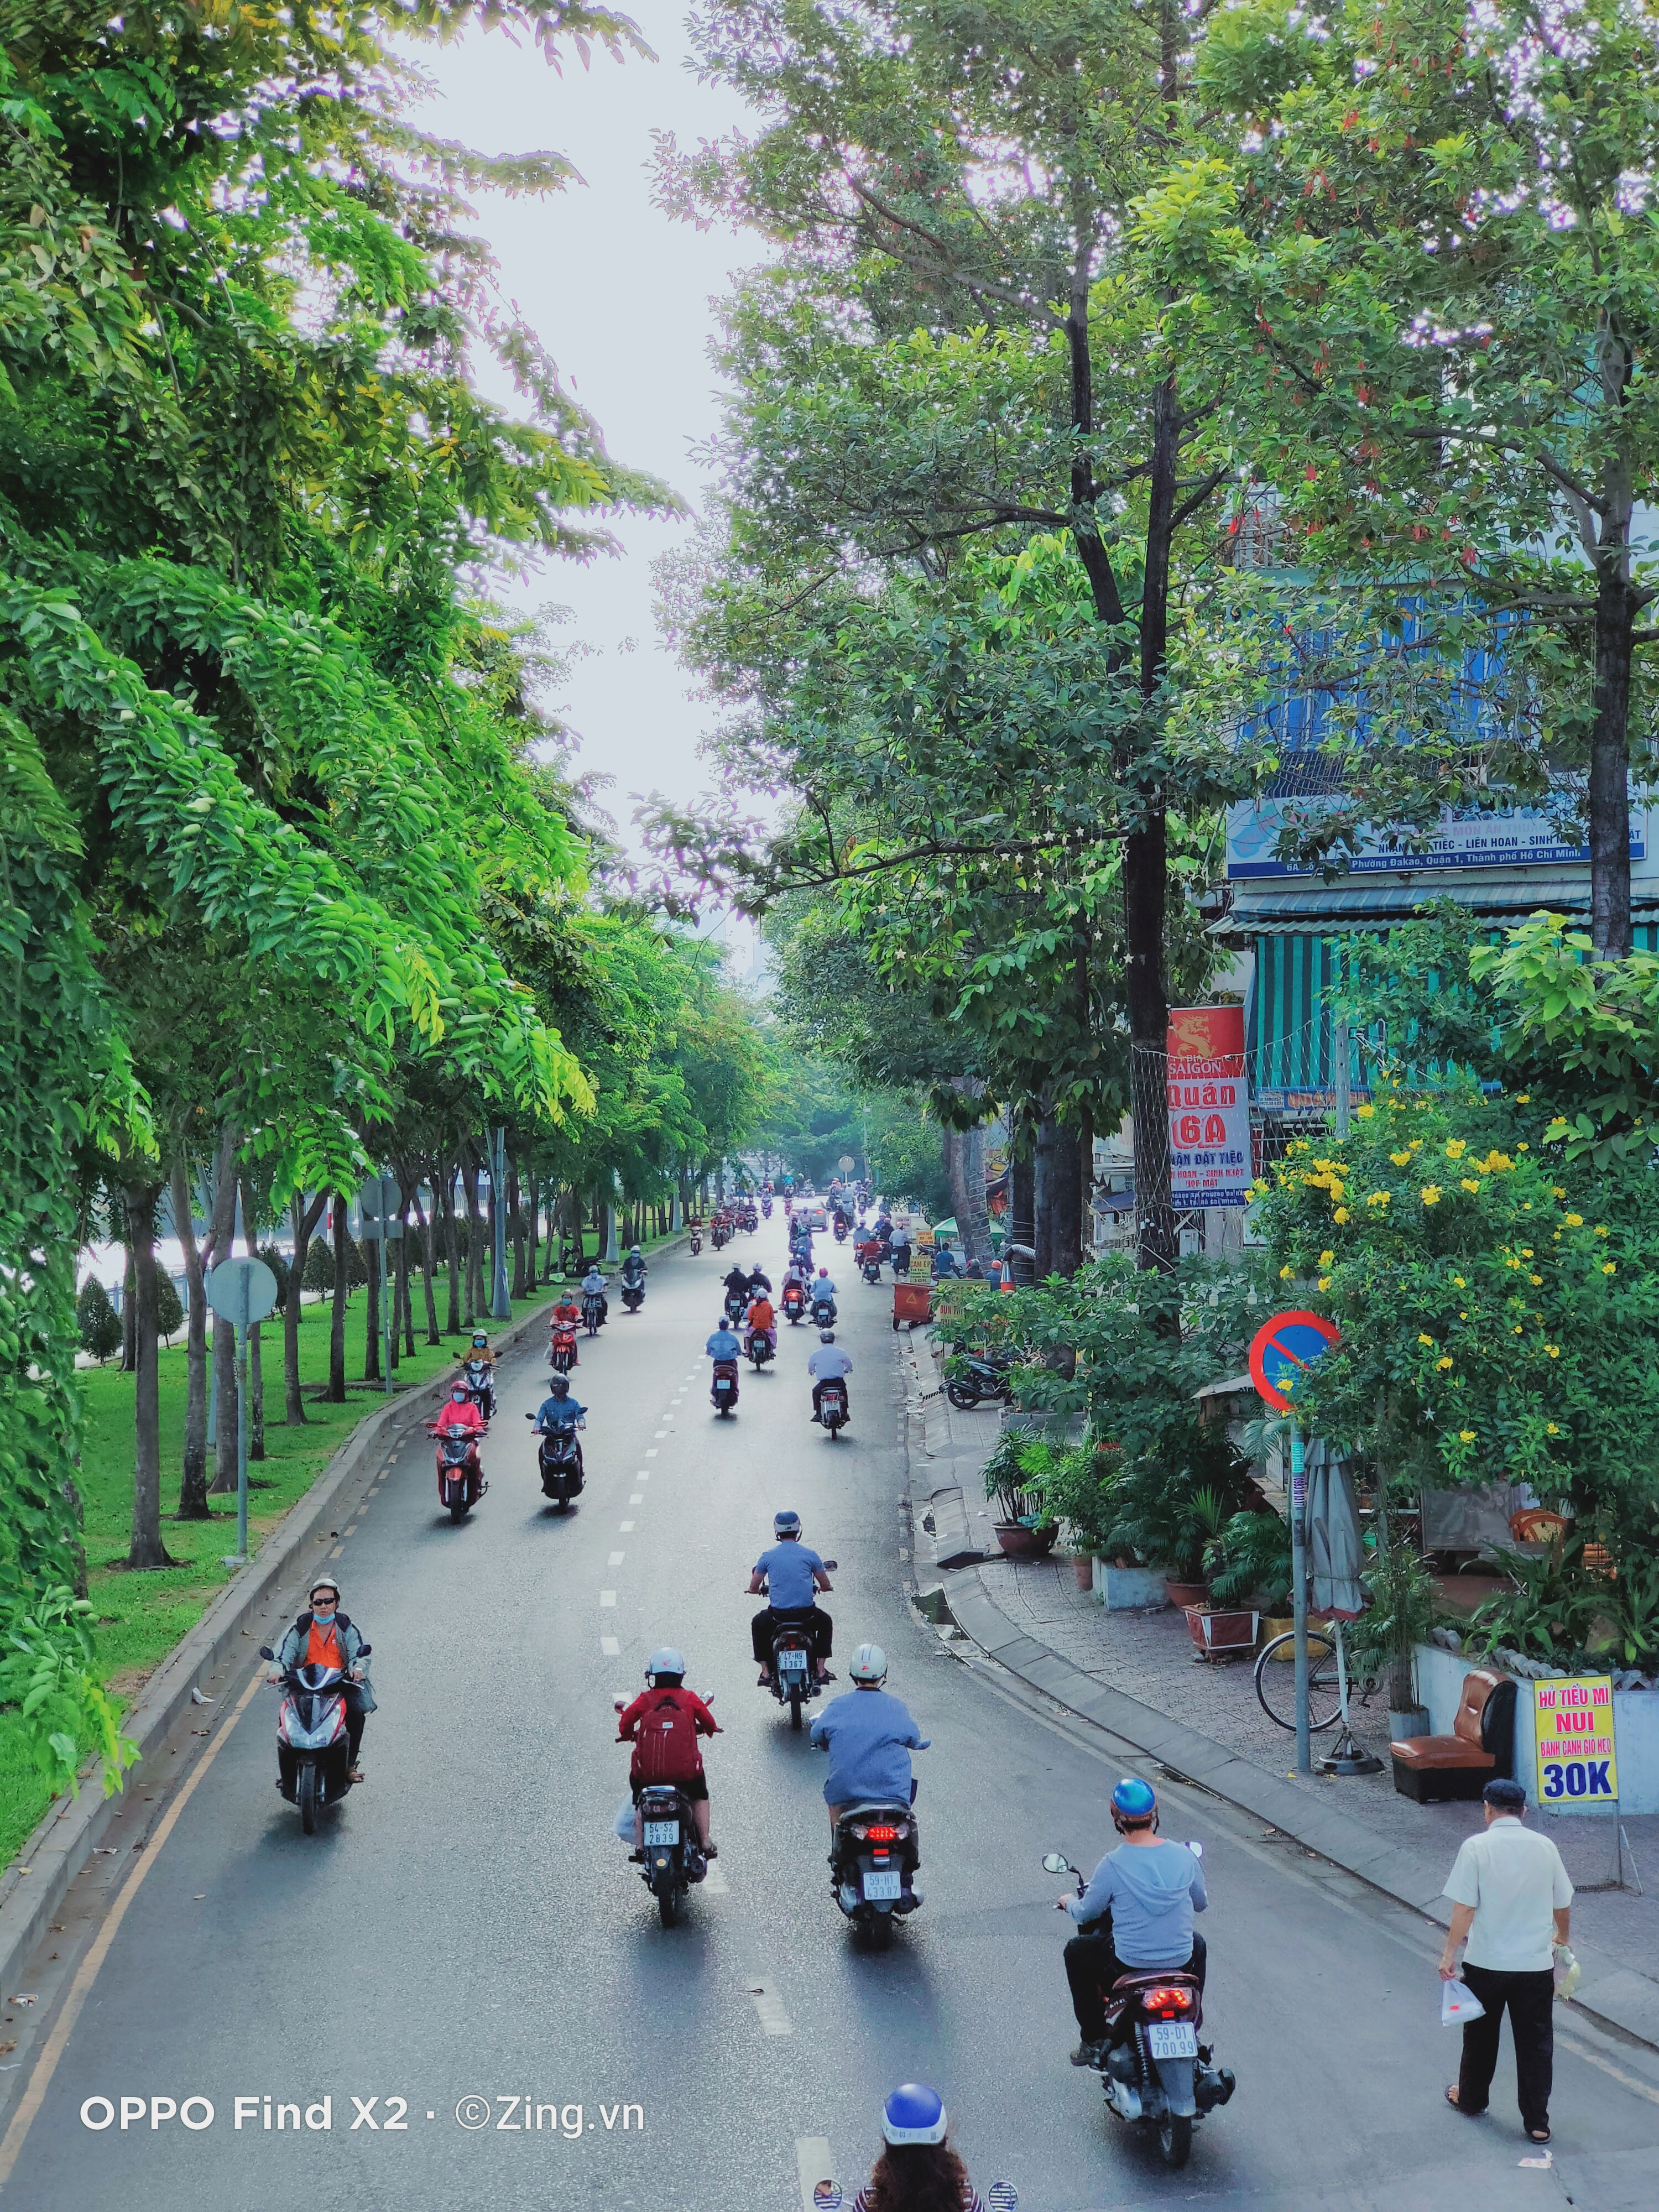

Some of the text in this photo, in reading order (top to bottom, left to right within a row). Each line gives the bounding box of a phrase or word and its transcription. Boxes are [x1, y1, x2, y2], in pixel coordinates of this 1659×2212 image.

[1433, 839, 1454, 851] TIỆC
[1466, 837, 1487, 848] LIÊN
[1491, 837, 1517, 847] HOAN
[1530, 835, 1553, 845] SINH
[1352, 859, 1387, 869] Phường
[1426, 853, 1451, 865] Quận
[1467, 852, 1498, 863] Thành
[1499, 850, 1518, 863] phố
[1521, 849, 1533, 859] Hồ
[1537, 849, 1554, 859] Chí
[1556, 848, 1580, 858] Minh
[1177, 1114, 1226, 1146] 6A
[1171, 1151, 1190, 1167] HẬN
[784, 1660, 802, 1668] 1367
[1540, 1683, 1609, 1708] HỦ TIẾU MÌ
[1556, 1712, 1594, 1733] NUI
[1541, 1739, 1560, 1757] BÁNH
[1563, 1740, 1582, 1756] CANH
[1598, 1738, 1611, 1753] HEO
[1544, 1761, 1612, 1797] 30K
[650, 1833, 673, 1844] 2839
[1156, 2026, 1186, 2040] 59-D1
[1155, 2041, 1194, 2056] 700.99
